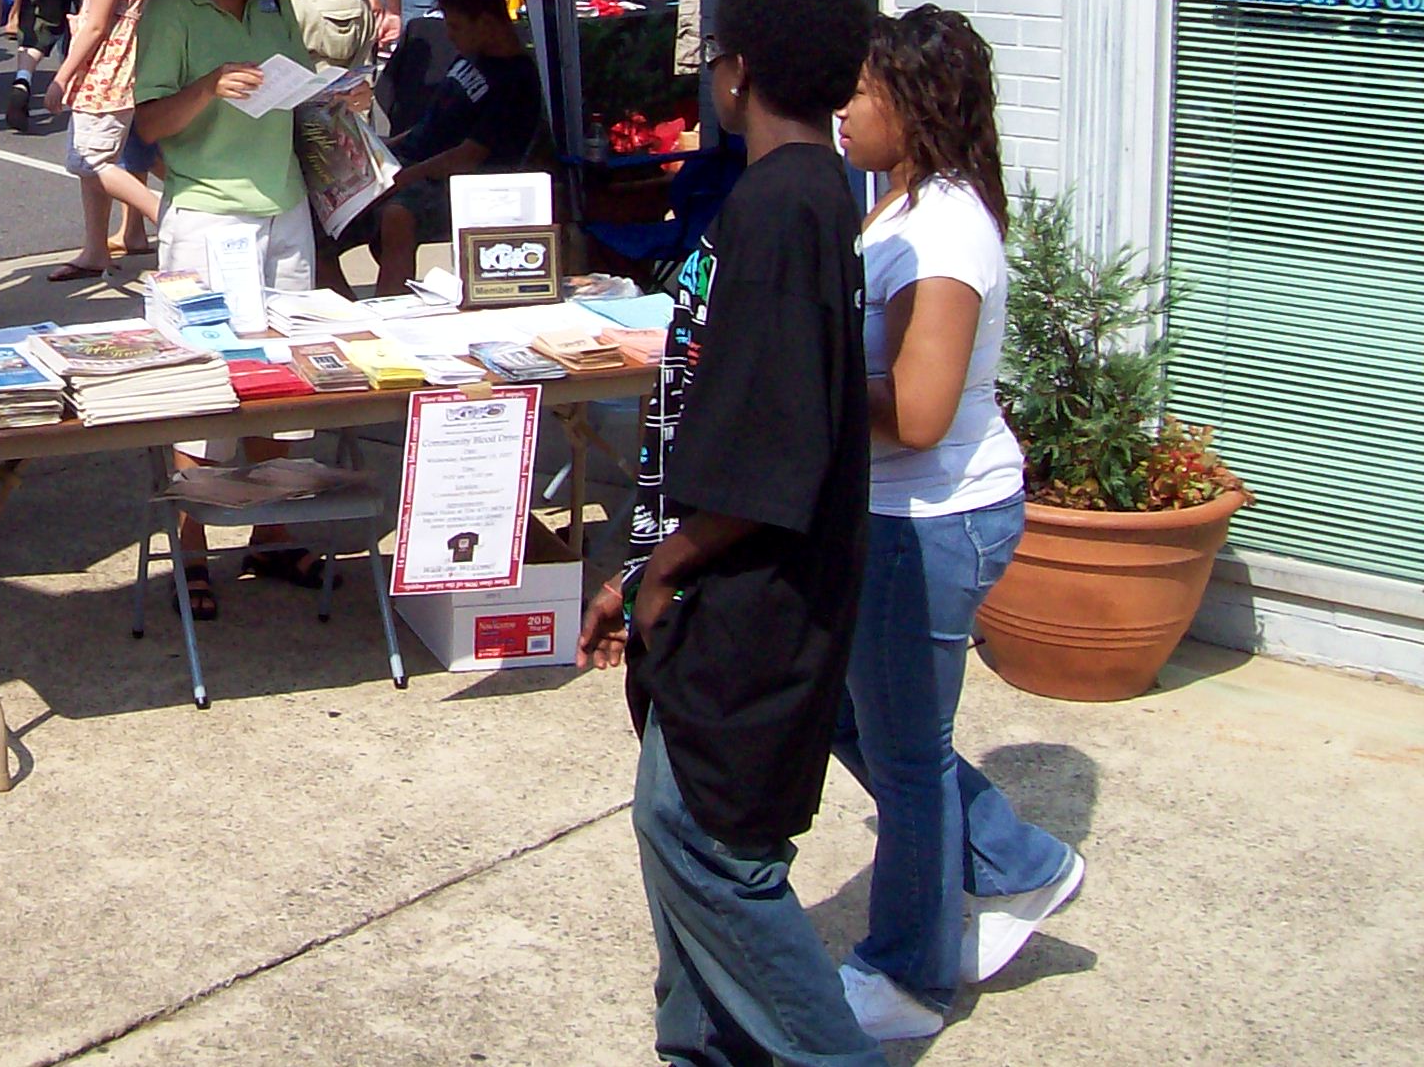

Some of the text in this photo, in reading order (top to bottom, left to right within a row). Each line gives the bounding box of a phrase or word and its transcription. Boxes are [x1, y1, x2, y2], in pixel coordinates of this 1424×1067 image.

[475, 286, 515, 295] Member
[422, 437, 471, 449] Community
[473, 436, 496, 445] Blood
[527, 615, 541, 626] 20
[542, 614, 552, 625] lb
